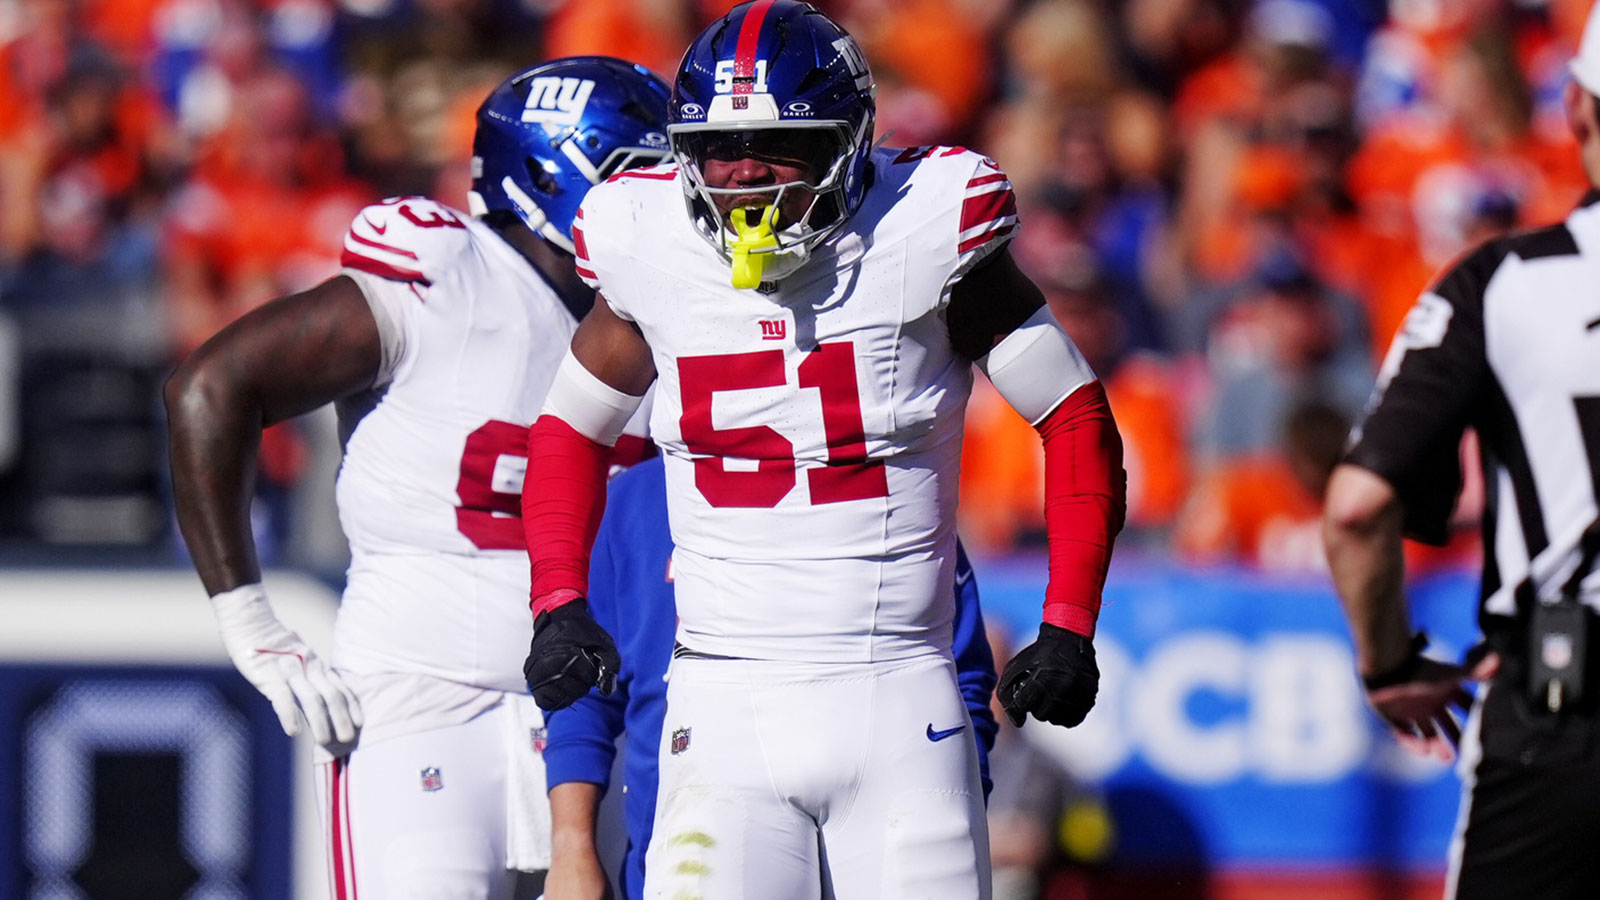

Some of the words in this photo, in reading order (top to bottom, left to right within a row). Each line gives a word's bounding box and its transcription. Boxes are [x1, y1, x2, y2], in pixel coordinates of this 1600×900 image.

[714, 59, 768, 94] 51
[521, 76, 596, 124] ny
[757, 319, 787, 341] ny
[677, 341, 888, 508] 51
